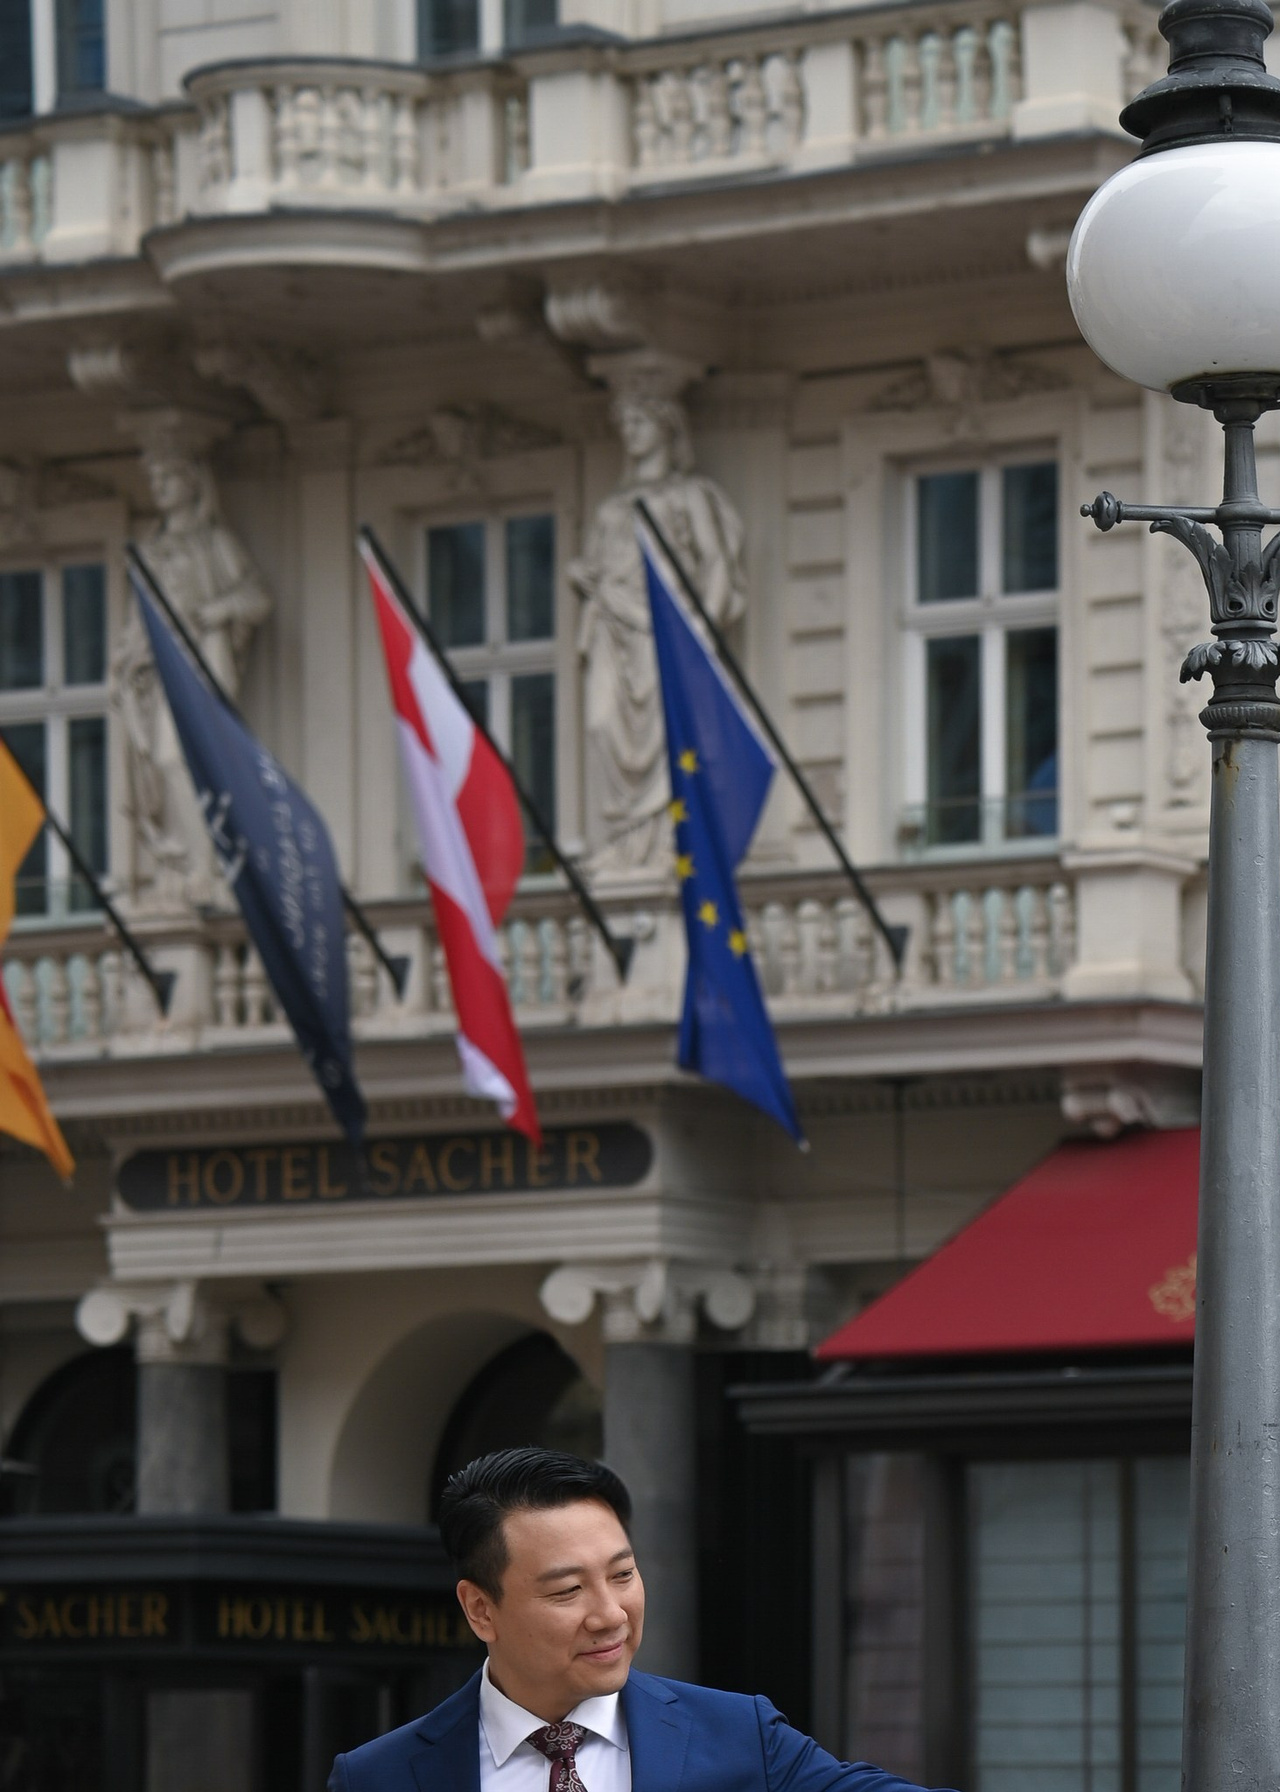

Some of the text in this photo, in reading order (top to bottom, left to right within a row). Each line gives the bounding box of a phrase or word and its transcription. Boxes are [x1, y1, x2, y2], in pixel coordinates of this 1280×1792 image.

[166, 1131, 602, 1202] HOTEL SACHER
[16, 1593, 169, 1639] SACHER
[218, 1598, 335, 1643] HOTEL
